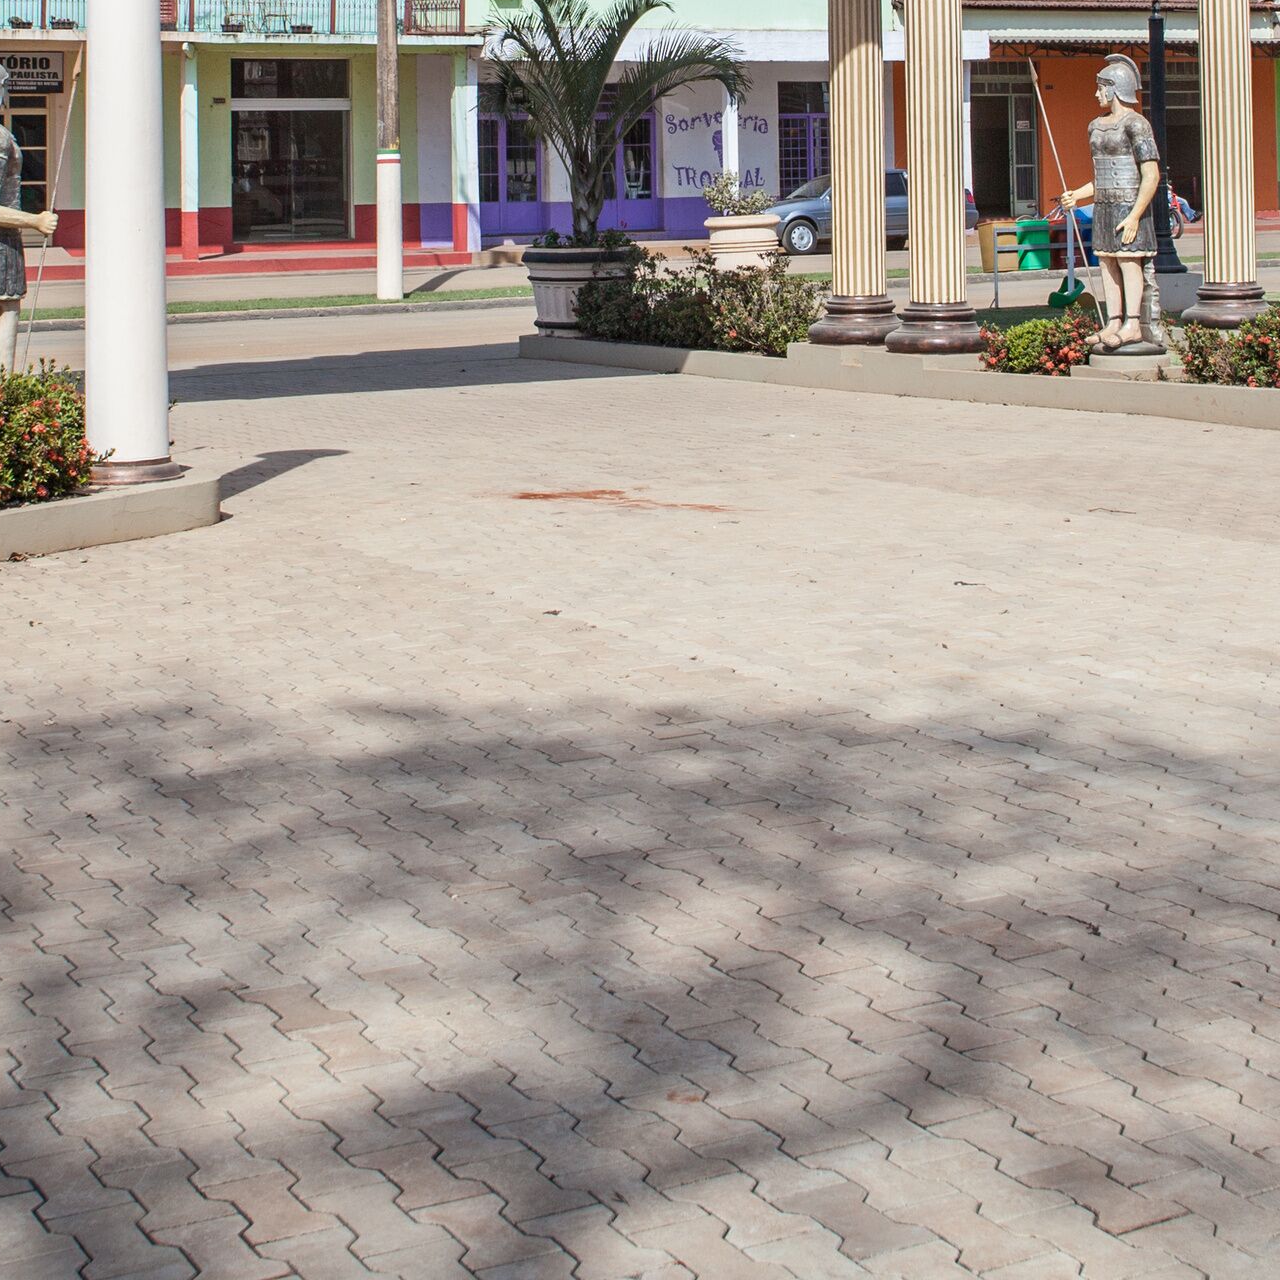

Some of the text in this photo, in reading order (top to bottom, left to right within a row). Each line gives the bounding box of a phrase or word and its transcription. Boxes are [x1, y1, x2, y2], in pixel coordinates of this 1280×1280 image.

[10, 71, 59, 80] PAULISTA
[665, 111, 769, 135] Sorveria
[672, 163, 766, 189] TROAL
